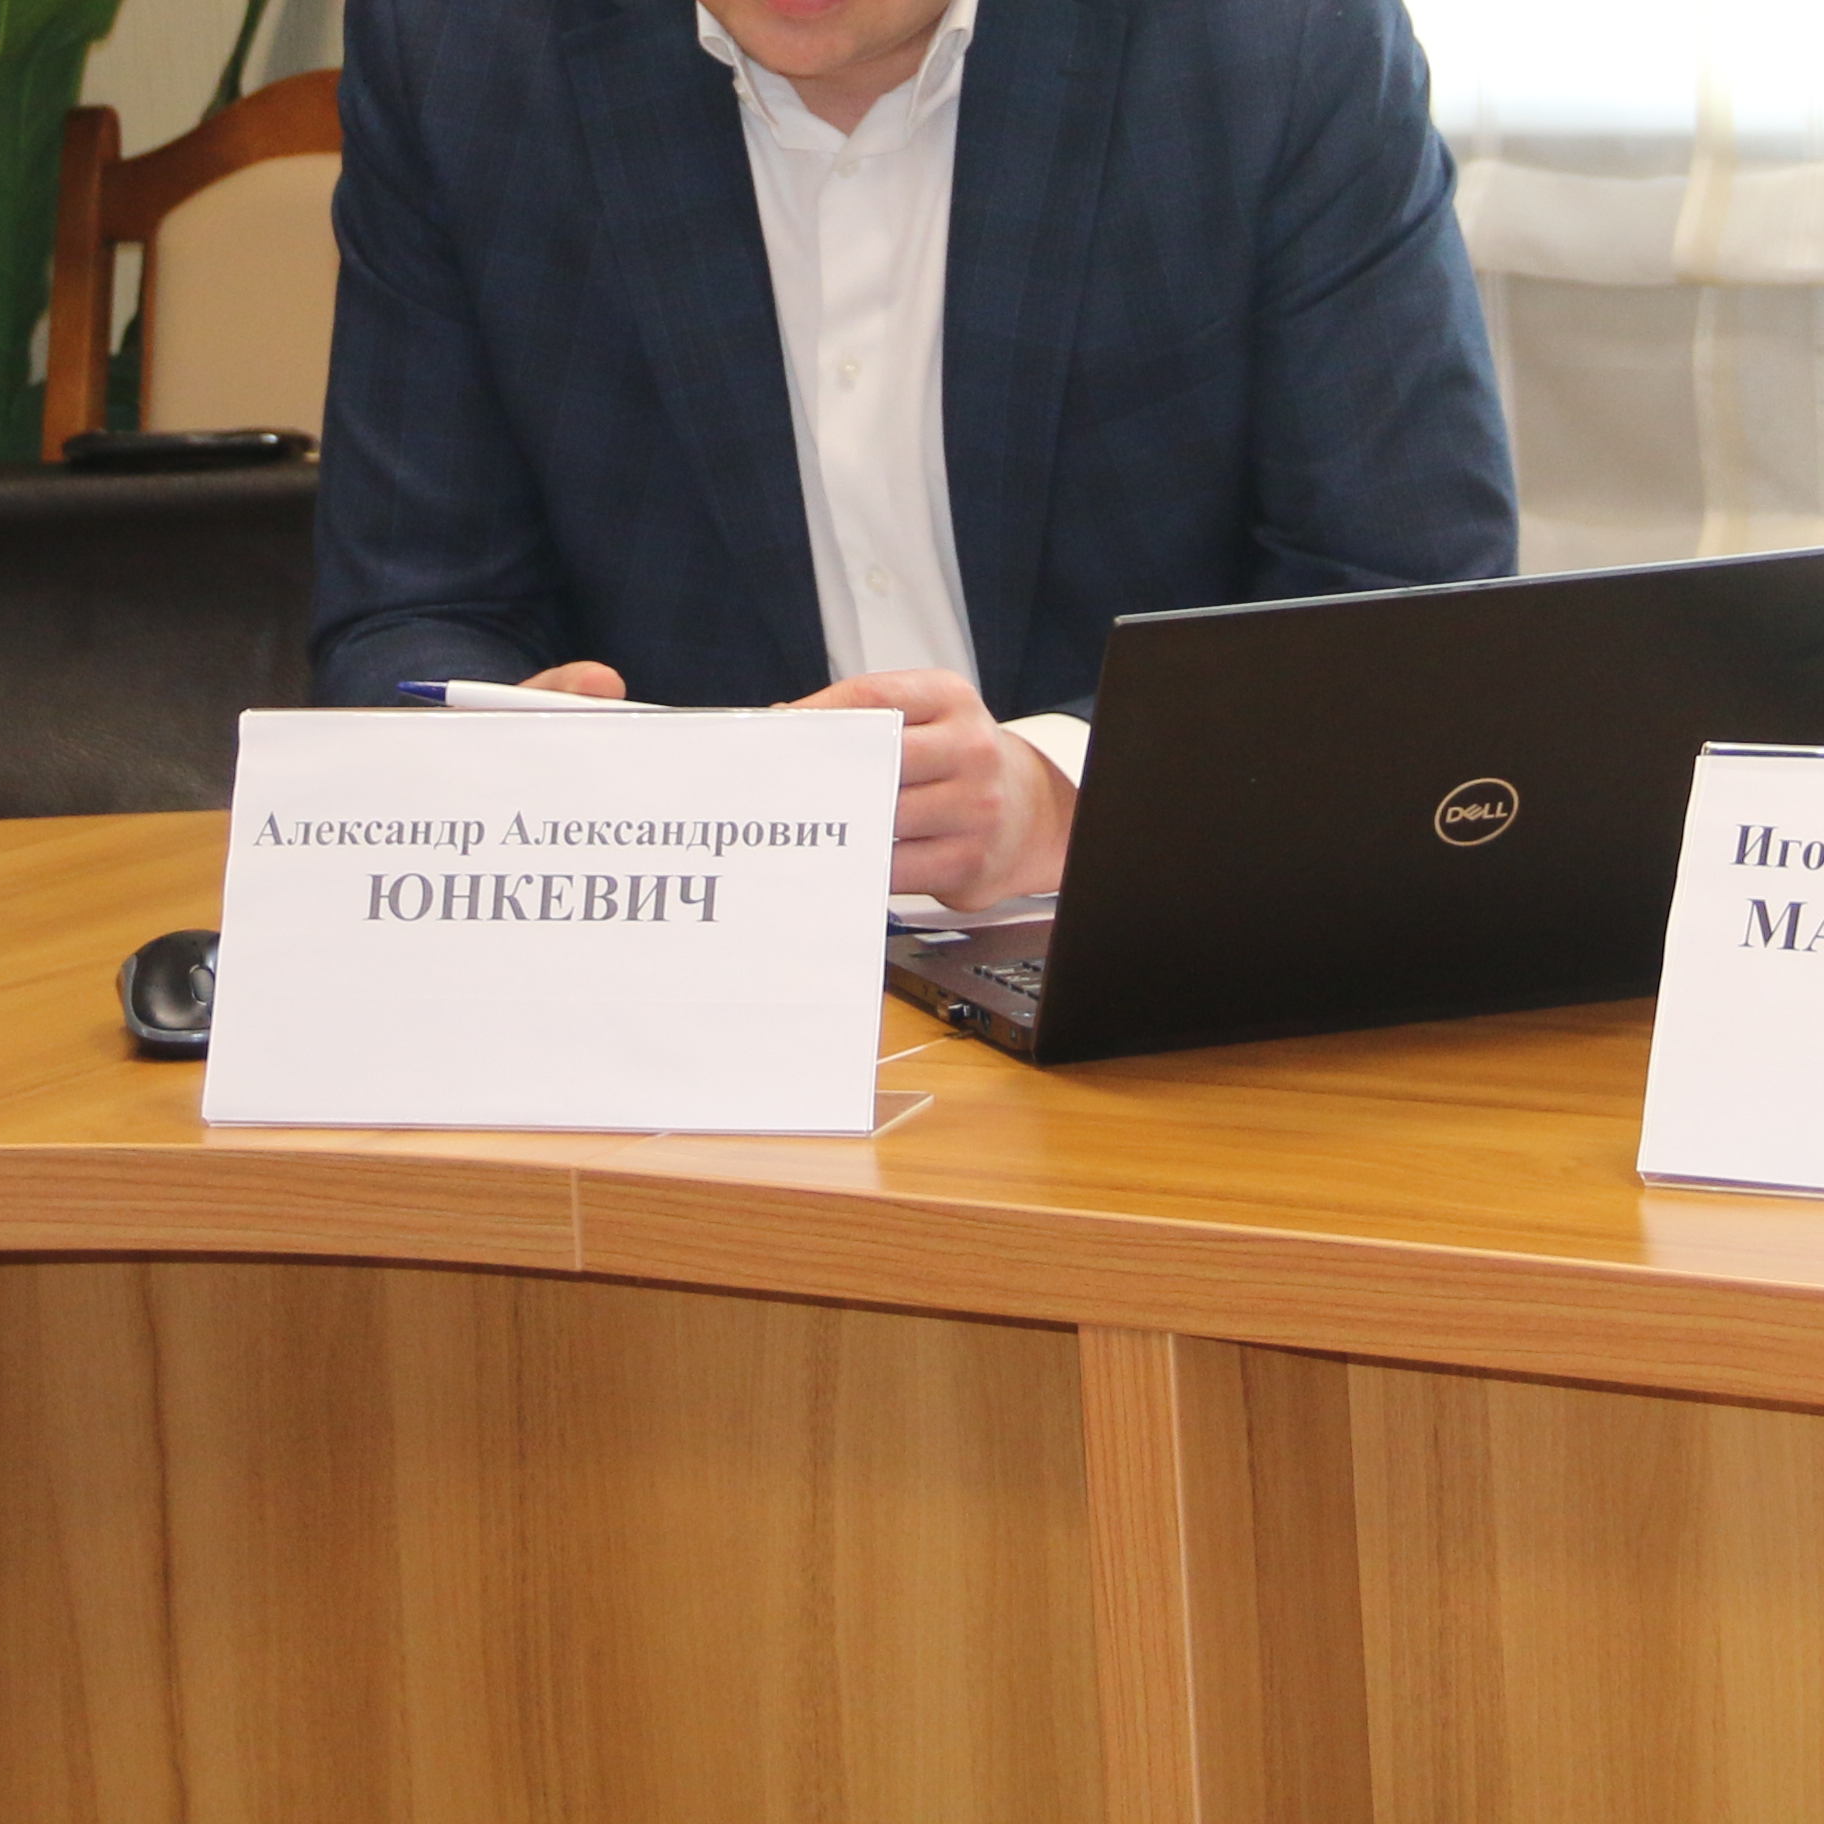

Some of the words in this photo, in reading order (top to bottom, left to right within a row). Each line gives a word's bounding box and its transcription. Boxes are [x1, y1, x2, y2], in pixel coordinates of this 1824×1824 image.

[253, 811, 486, 856] Александр
[499, 810, 849, 856] Александрович
[1444, 801, 1509, 824] DELL
[363, 872, 723, 923] ЮНКЕВИЧ
